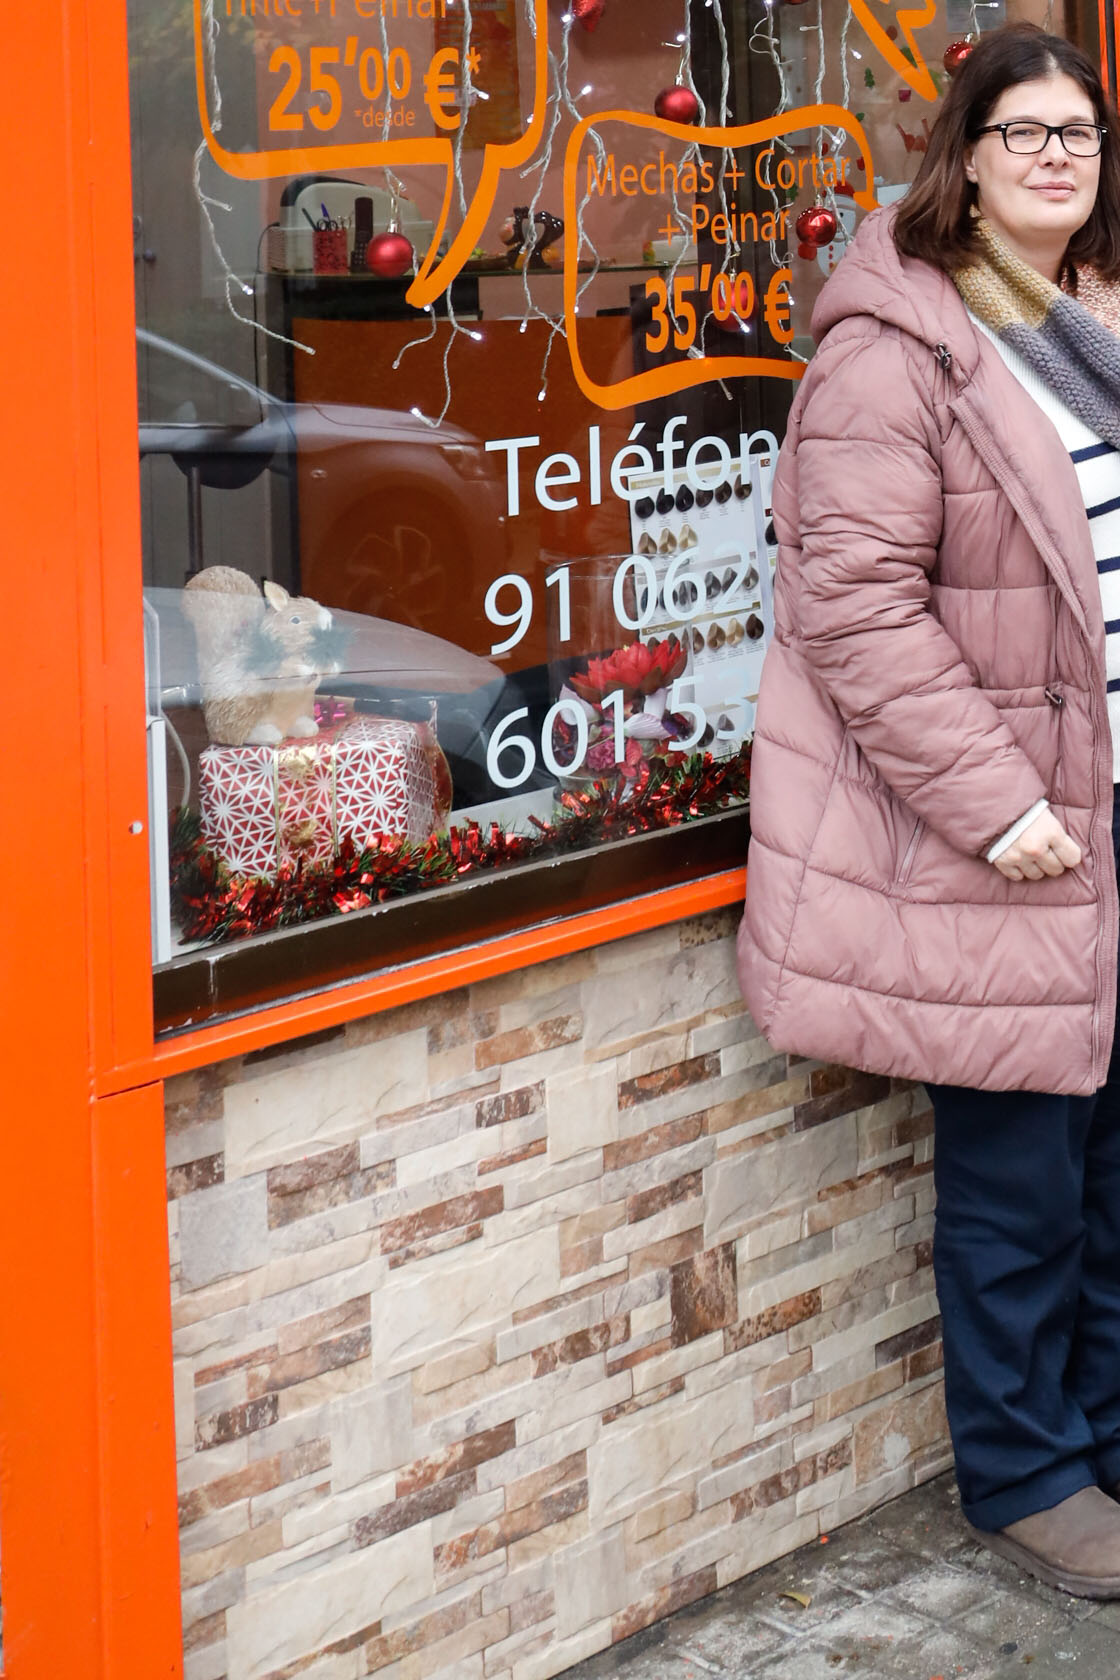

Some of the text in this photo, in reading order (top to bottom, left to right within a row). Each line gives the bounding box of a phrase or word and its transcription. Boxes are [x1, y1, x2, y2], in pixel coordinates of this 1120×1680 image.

[586, 150, 715, 197] Mechas
[755, 149, 850, 191] Cortar
[692, 202, 791, 246] Peinar
[485, 415, 779, 518] Teléfon
[484, 541, 754, 656] 91 062
[486, 688, 626, 790] 601
